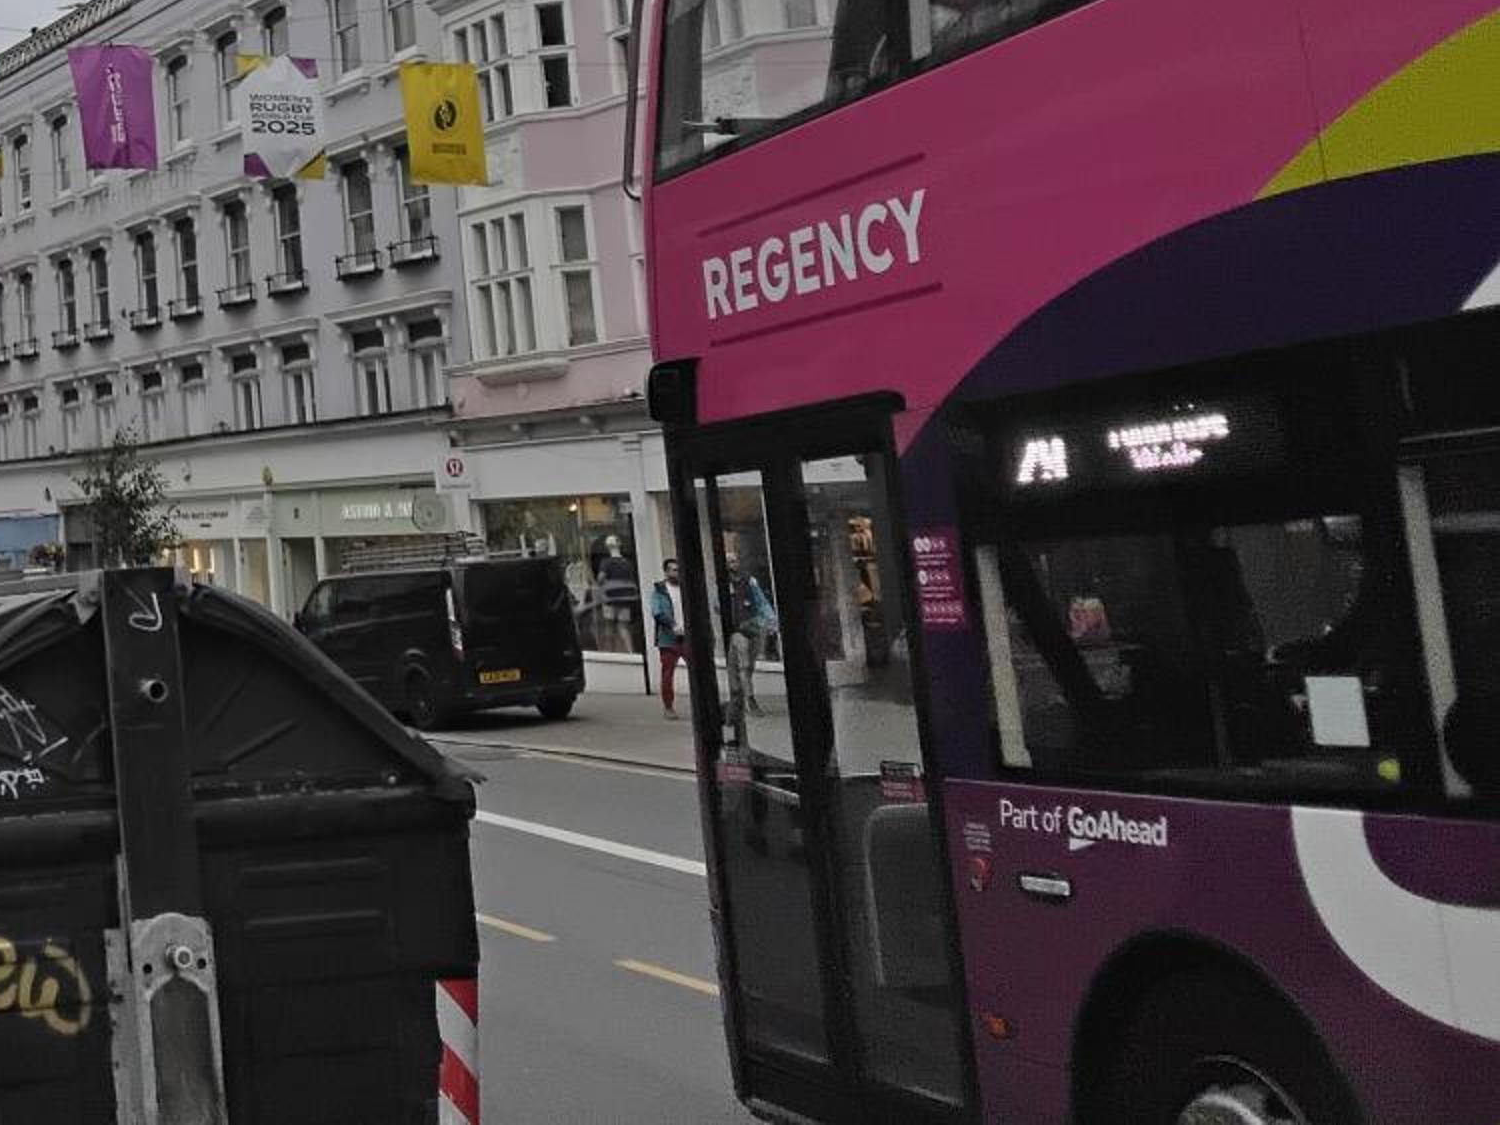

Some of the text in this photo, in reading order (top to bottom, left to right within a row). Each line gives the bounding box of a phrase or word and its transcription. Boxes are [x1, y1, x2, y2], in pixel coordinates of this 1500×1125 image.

[249, 101, 312, 114] RUGBY
[251, 119, 316, 136] 2025
[703, 188, 927, 320] REGENCY
[1000, 799, 1168, 847] Part of GoAhead
